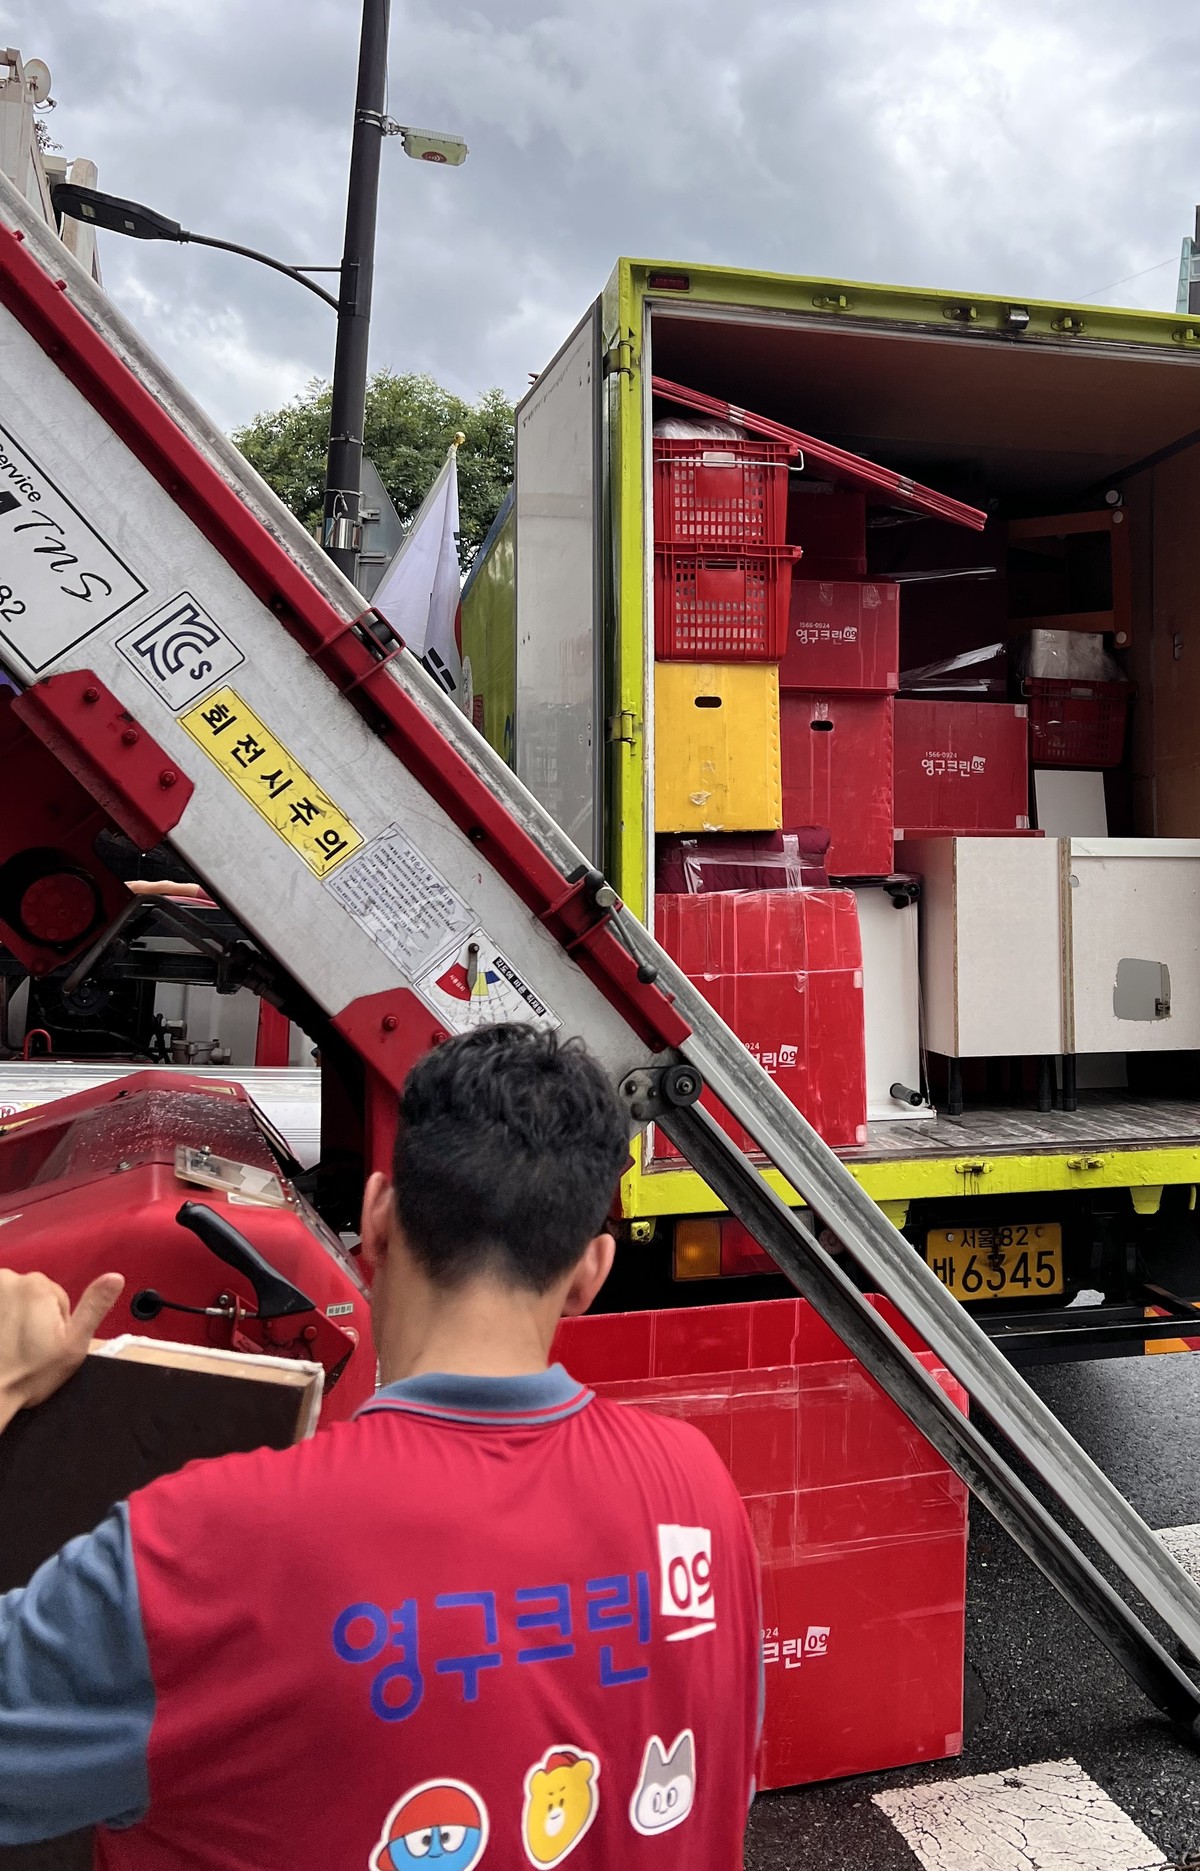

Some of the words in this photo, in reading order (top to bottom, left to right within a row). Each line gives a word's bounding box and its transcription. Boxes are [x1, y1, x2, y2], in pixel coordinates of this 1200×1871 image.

[0, 443, 42, 502] ervice
[795, 629, 843, 645] 영구크린
[925, 751, 958, 759] 1566-0924
[921, 759, 971, 777] 영구크린
[331, 1570, 652, 1723] 영구크린
